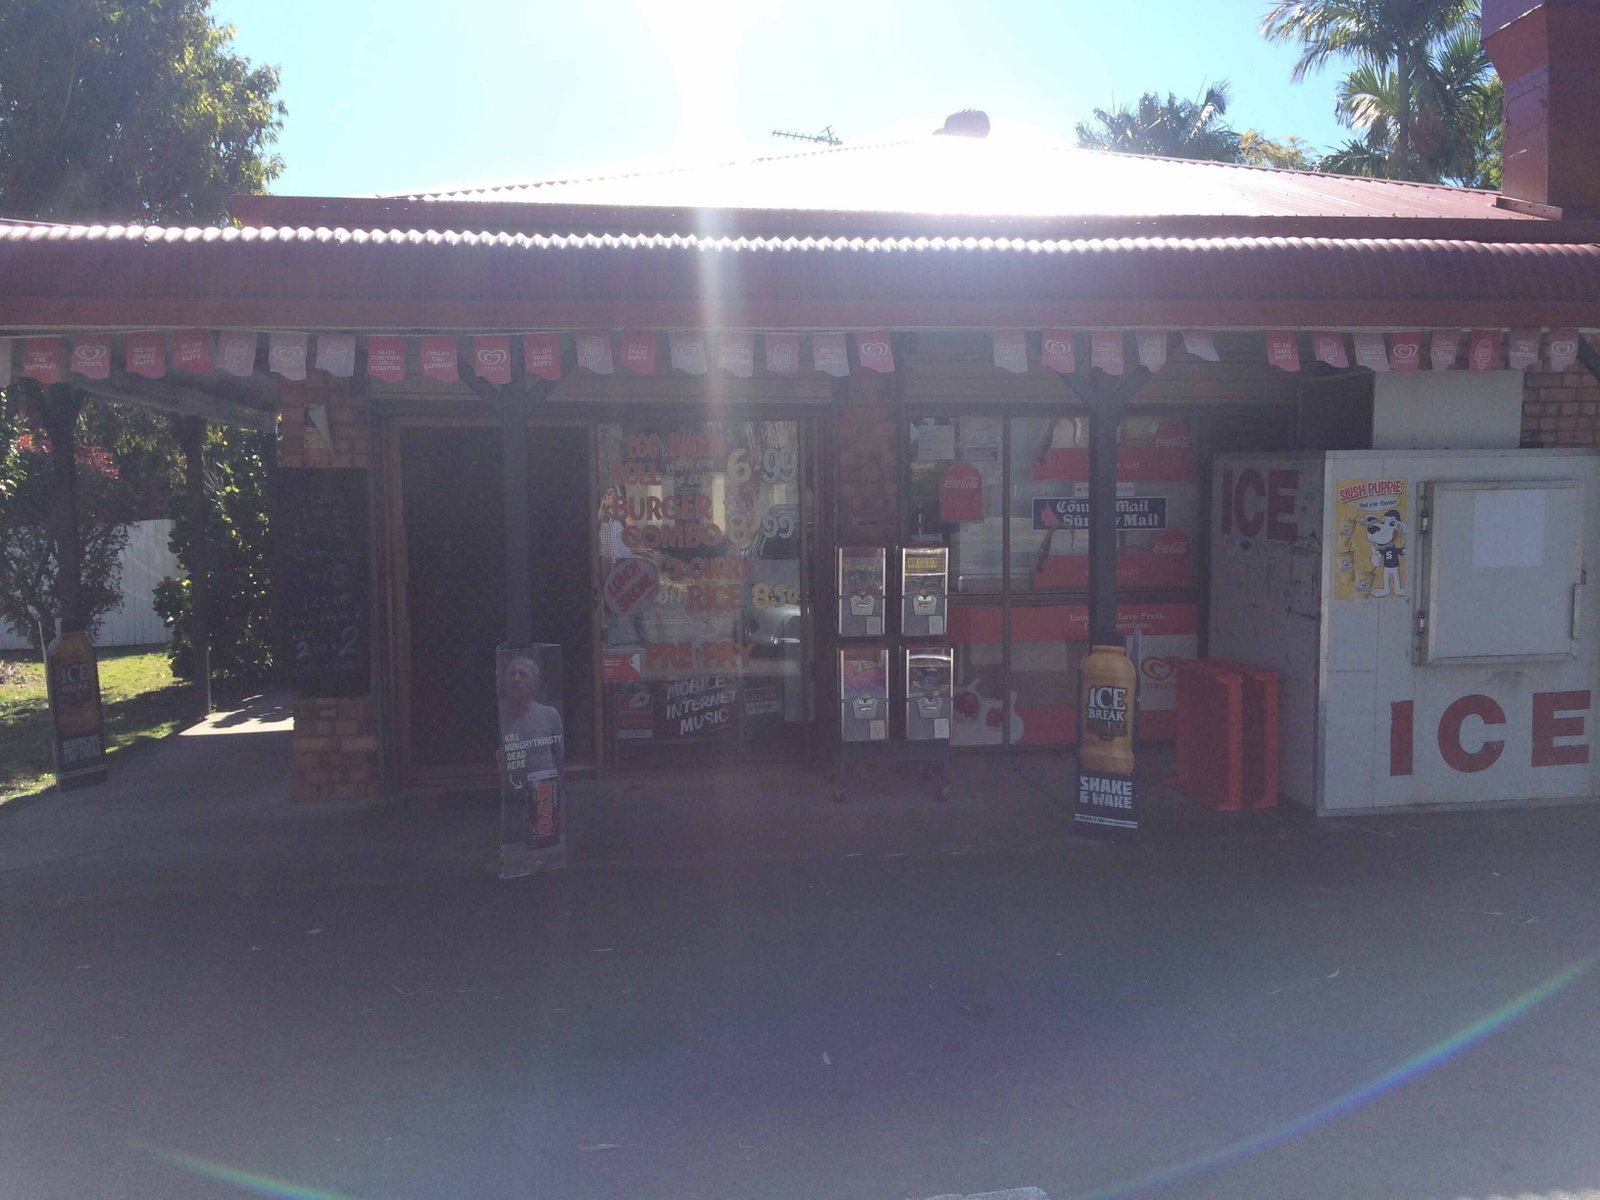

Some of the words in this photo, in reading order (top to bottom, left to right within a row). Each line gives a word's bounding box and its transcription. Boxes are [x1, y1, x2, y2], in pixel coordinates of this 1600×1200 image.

[944, 477, 979, 488] Coca-Cola
[1339, 483, 1367, 502] SLUSH
[1367, 480, 1402, 496] PUPPIE
[613, 495, 714, 521] BURGER
[1116, 500, 1149, 513] Mail
[1221, 468, 1299, 542] ICE
[1123, 514, 1159, 527] Mail
[623, 524, 724, 549] COMBO
[1386, 550, 1393, 560] S
[653, 591, 681, 605] ON
[666, 675, 727, 700] MOBILE
[667, 690, 737, 719] INTERNET
[1088, 686, 1127, 711] ICE
[680, 708, 729, 735] MUSIC
[1088, 709, 1126, 722] BREAK
[504, 733, 520, 743] KILL
[1390, 690, 1591, 776] ICE
[507, 750, 527, 761] DEAD
[507, 760, 526, 771] HERE
[1079, 775, 1133, 796] SHAKE
[1079, 791, 1089, 803] &
[1092, 792, 1133, 809] WAKE
